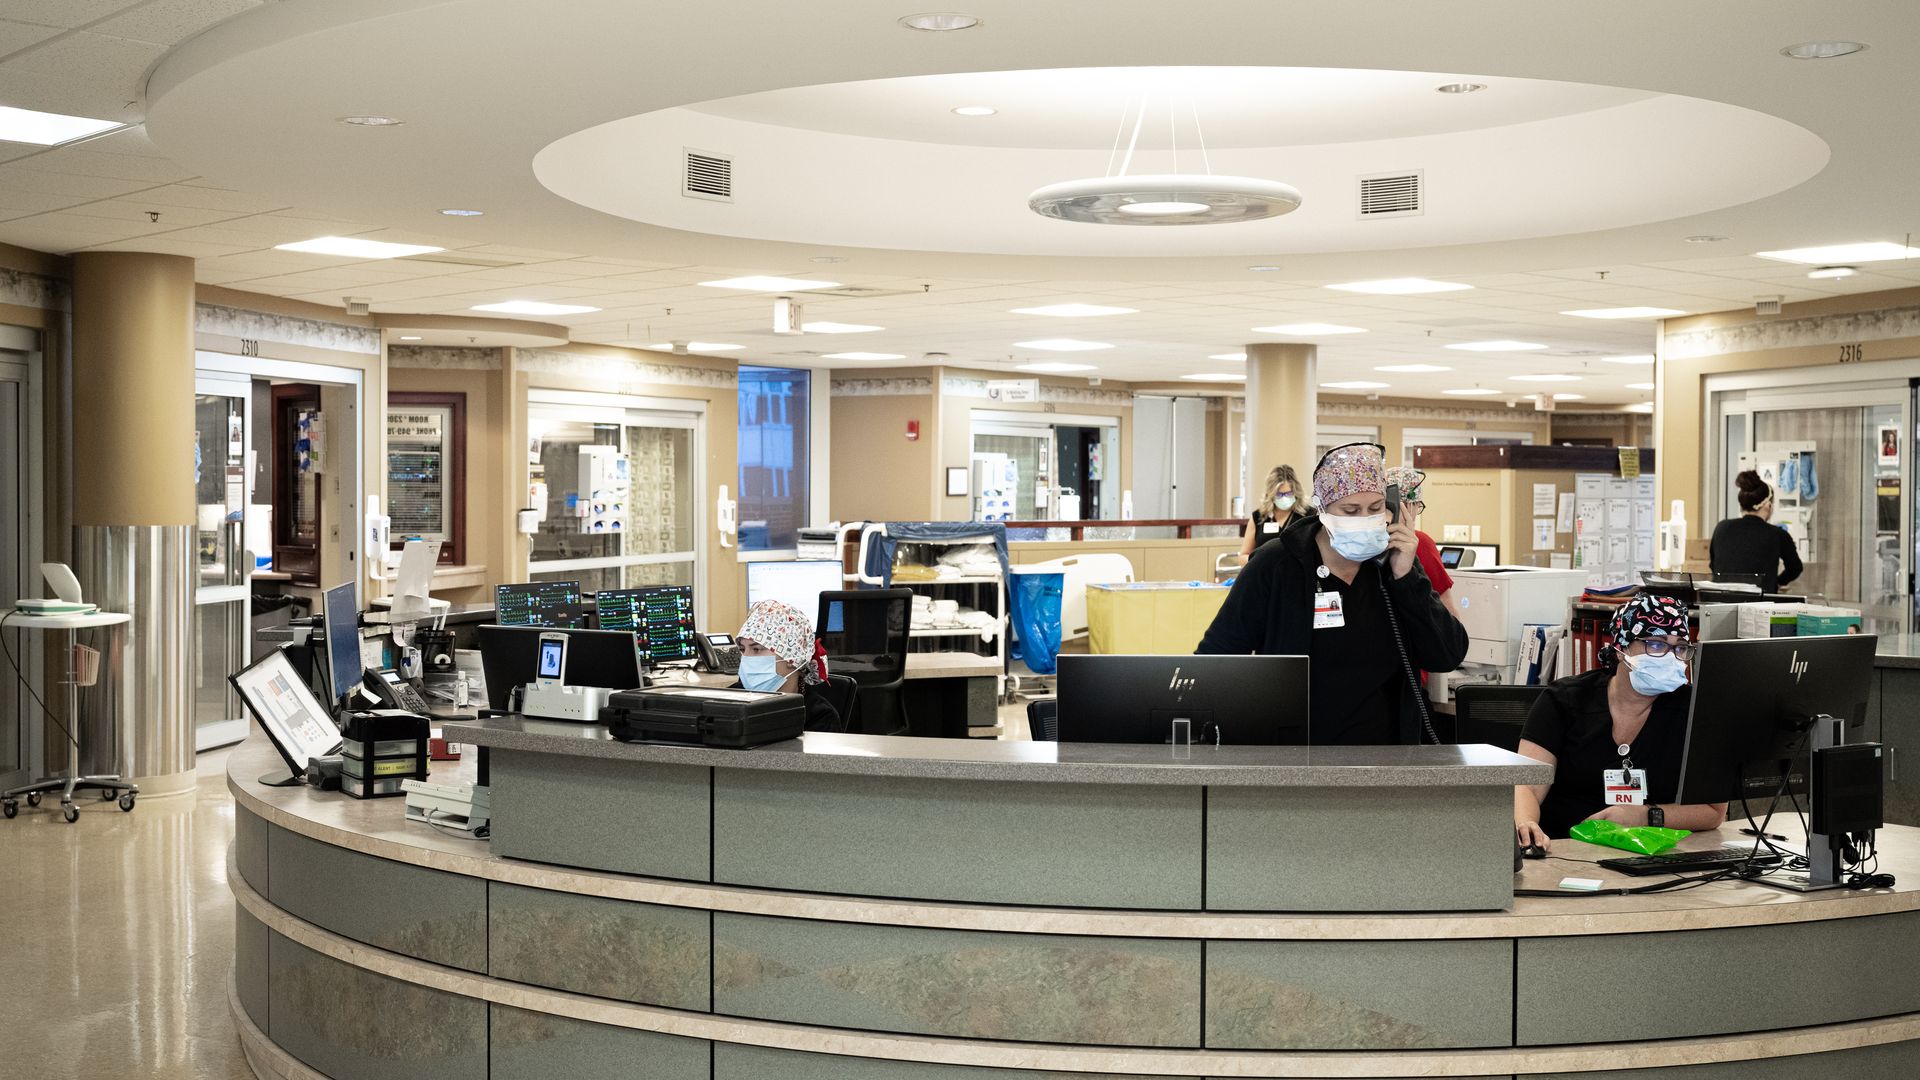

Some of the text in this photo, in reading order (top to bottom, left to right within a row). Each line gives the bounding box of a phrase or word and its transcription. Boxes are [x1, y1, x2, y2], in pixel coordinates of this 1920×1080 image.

[241, 339, 258, 357] 2310
[1840, 344, 1862, 362] 2316
[1615, 794, 1633, 803] RN
